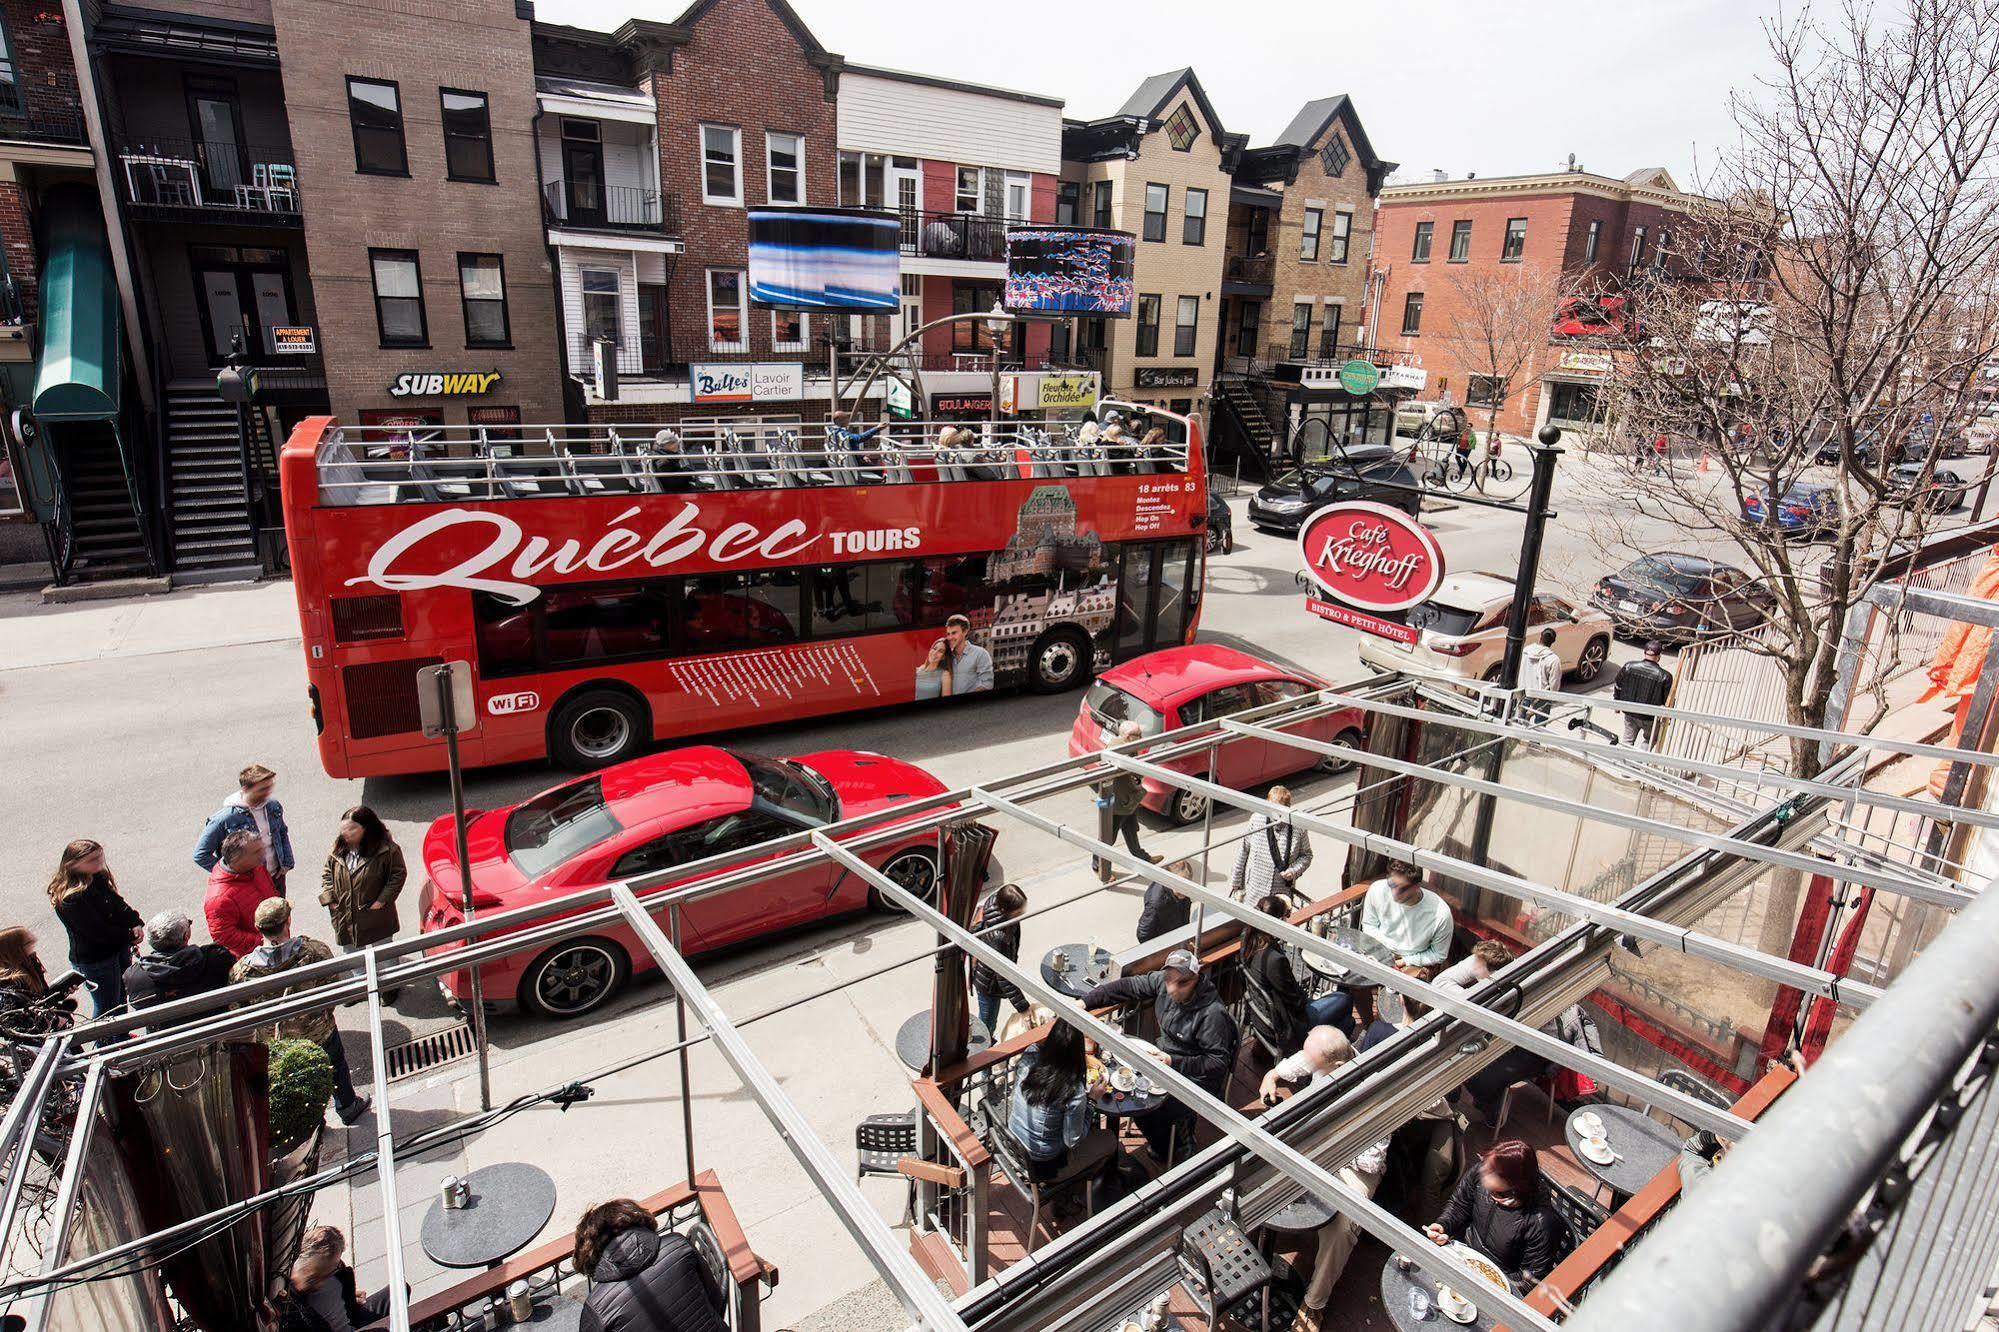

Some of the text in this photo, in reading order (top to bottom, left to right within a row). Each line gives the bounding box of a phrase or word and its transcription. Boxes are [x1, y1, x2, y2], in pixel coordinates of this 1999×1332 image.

[275, 328, 310, 337] APPARTEMENT
[391, 373, 501, 396] SUBWAY
[699, 374, 748, 394] Bulles
[755, 373, 790, 384] Lavoir
[753, 384, 792, 396] Cartier
[1043, 392, 1080, 403] Orchidée
[939, 399, 992, 411] BOULANGER
[1138, 483, 1179, 494] 18 arrêts
[1184, 482, 1196, 492] 83
[1136, 504, 1171, 512] Descendez
[1349, 521, 1389, 548] Café
[344, 501, 920, 606] Québec TOURS
[1315, 535, 1423, 589] Krieghoff
[1311, 603, 1410, 641] BISTRO & PETIT HÔTEL
